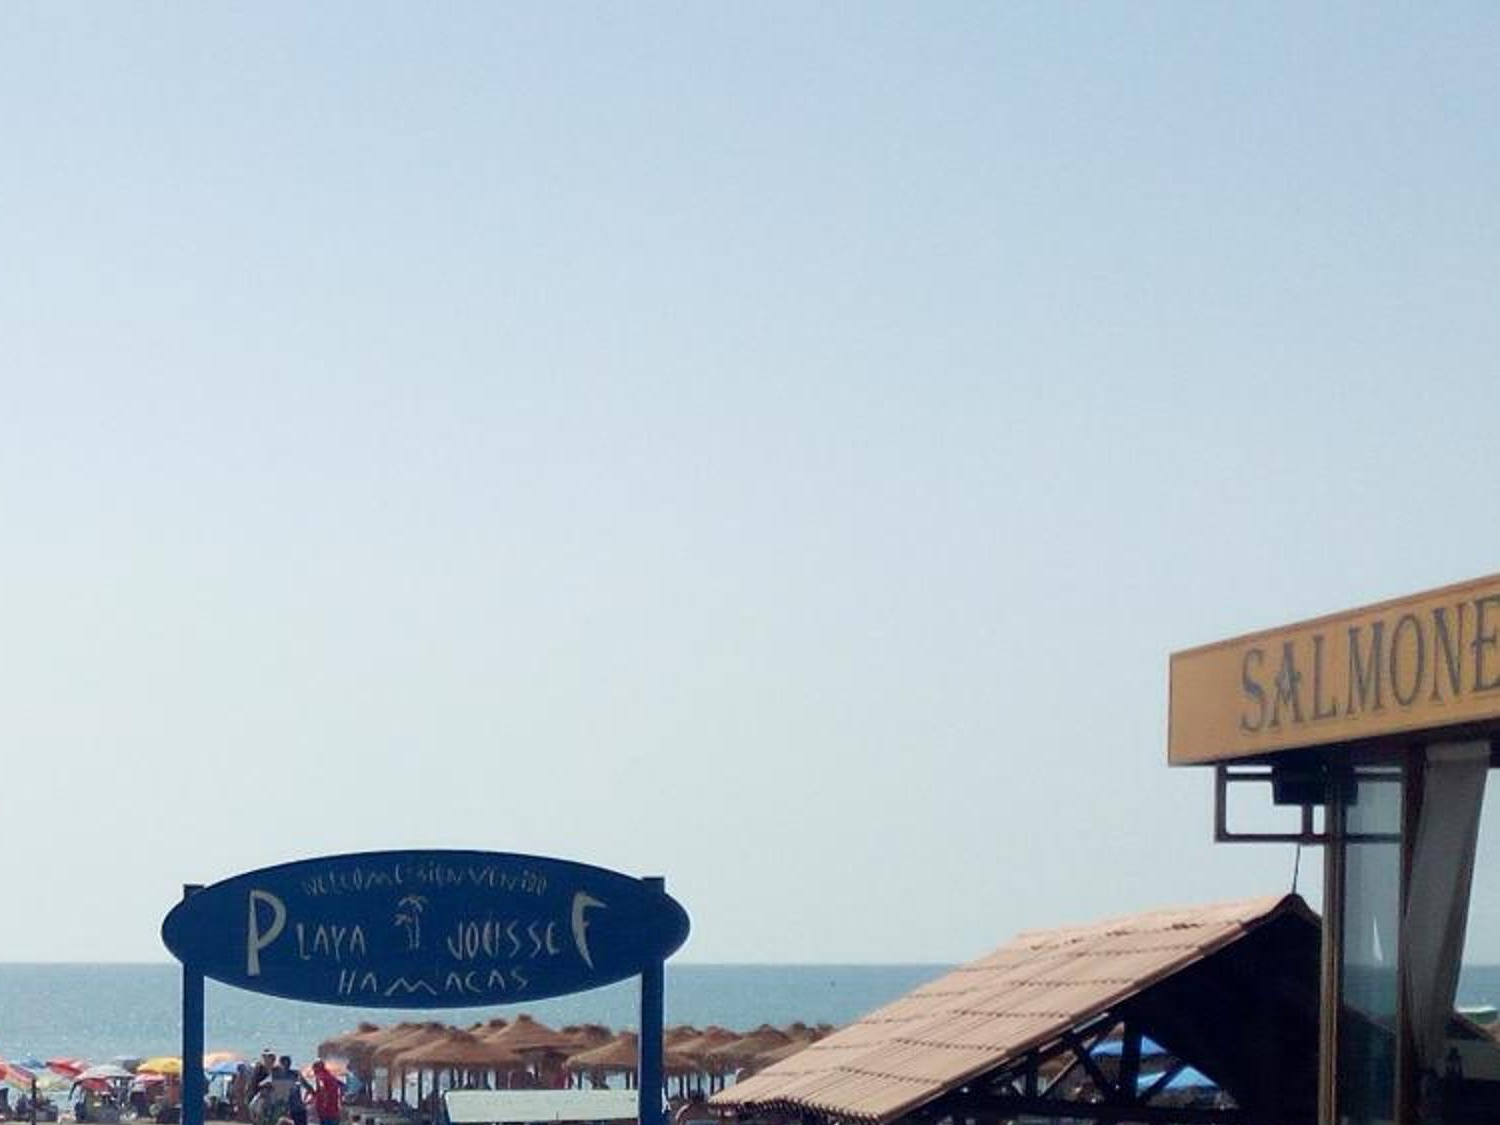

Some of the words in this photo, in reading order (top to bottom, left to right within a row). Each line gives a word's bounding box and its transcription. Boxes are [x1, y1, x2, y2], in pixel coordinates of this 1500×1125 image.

[1239, 594, 1500, 734] SALMONE
[246, 888, 368, 977] PLAYA
[338, 967, 529, 998] HAMACAS
